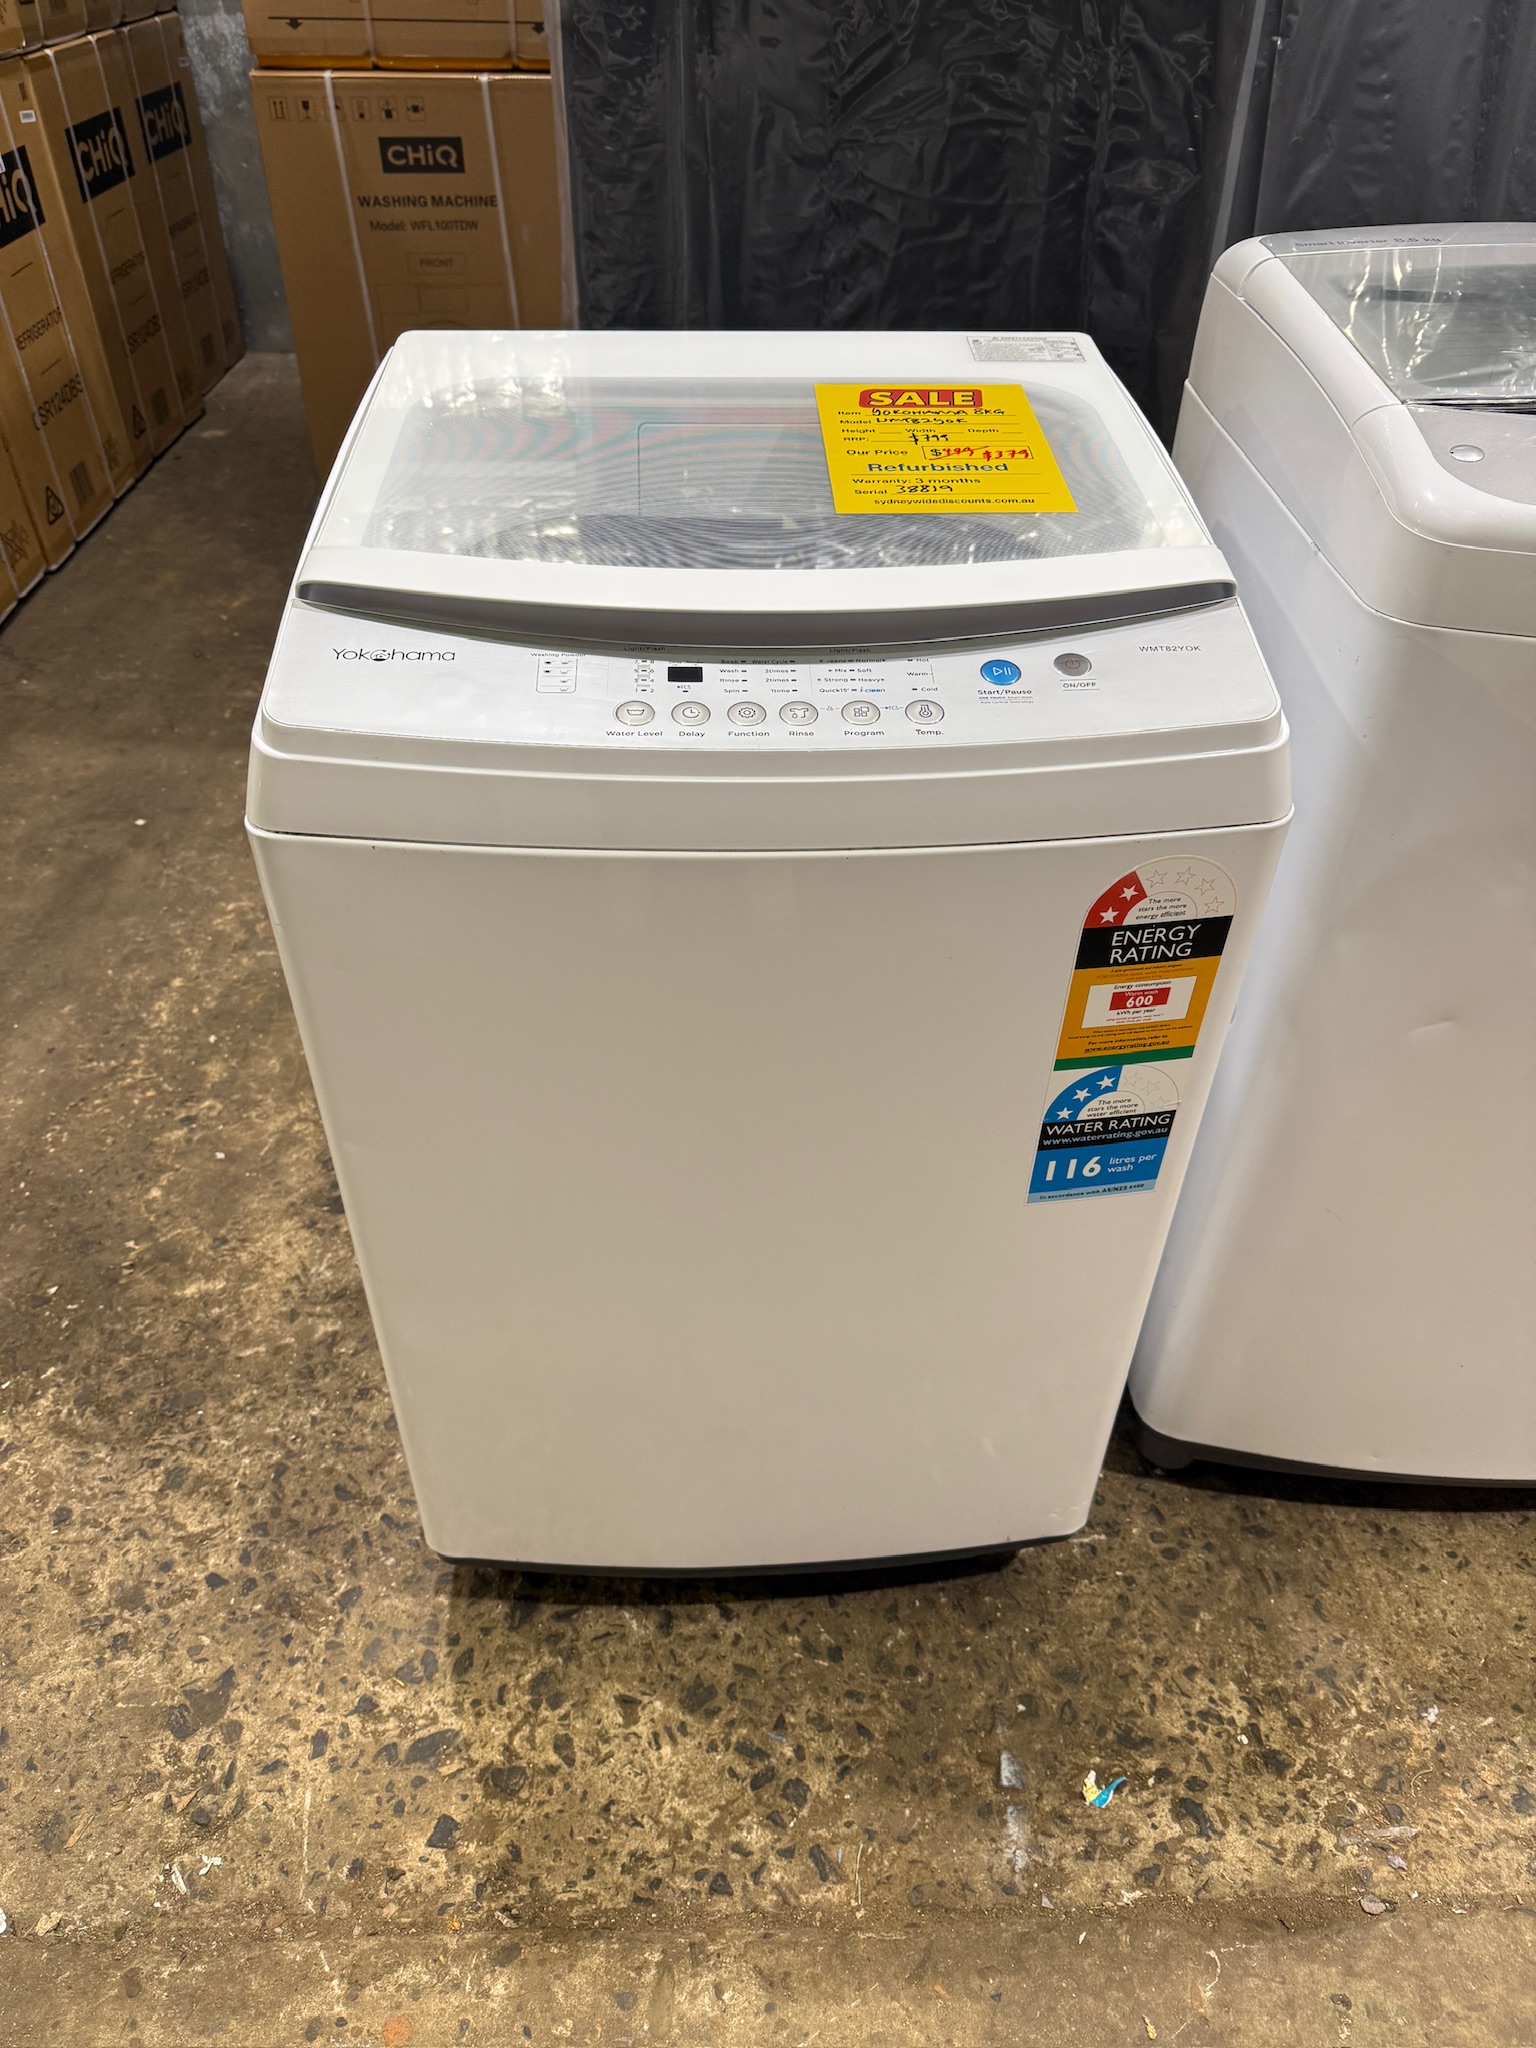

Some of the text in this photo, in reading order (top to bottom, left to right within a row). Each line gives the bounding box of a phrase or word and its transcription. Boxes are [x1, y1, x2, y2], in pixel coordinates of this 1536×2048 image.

[76, 126, 129, 182] CHiQ
[386, 145, 459, 168] CHiQ
[357, 195, 498, 208] WASHING MACHINE
[369, 220, 407, 232] Model:
[419, 258, 454, 268] FRONT
[867, 390, 976, 407] SALE
[982, 449, 1030, 462] $379
[867, 463, 1009, 472] Refurbished
[874, 498, 1035, 506] sydneywidediscounts.com.au
[678, 730, 706, 738] Delay
[915, 729, 944, 737] Temp.
[1135, 910, 1186, 921] energy efficient
[1111, 924, 1201, 947] ENERGY
[1109, 942, 1193, 965] RATING
[1135, 980, 1172, 988] consumption
[1126, 995, 1154, 1008] 600
[1084, 1040, 1170, 1053] www.energyrating.gov.au
[1109, 1108, 1137, 1116] efficient
[1046, 1114, 1172, 1136] WATER RATING
[1042, 1127, 1168, 1146] www.waterrating.gov.au
[1045, 1153, 1157, 1181] 116 litres per
[1107, 1164, 1134, 1173] wash
[1047, 1191, 1084, 1199] accordance
